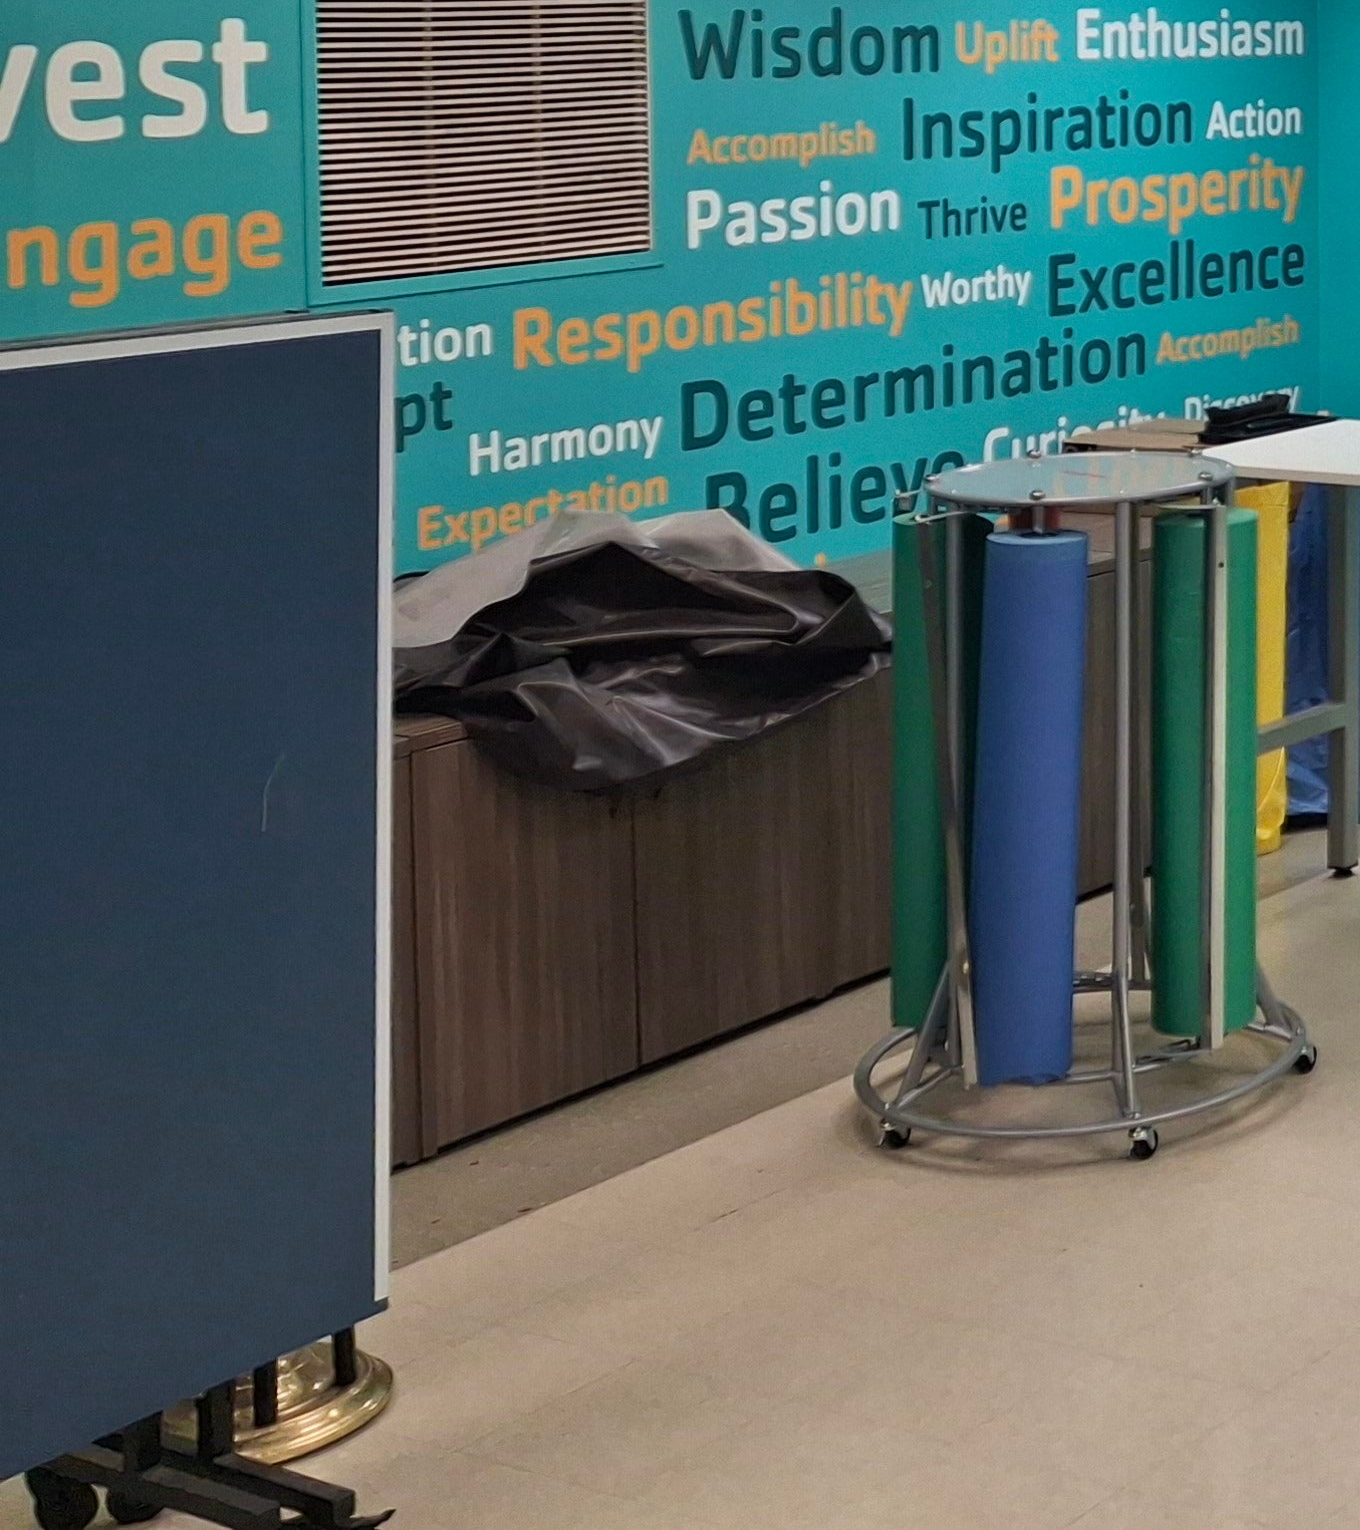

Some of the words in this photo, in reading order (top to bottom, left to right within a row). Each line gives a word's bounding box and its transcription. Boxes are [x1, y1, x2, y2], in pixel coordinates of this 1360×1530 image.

[679, 7, 938, 80] Wisdom
[957, 21, 1058, 73] Uplift
[1077, 8, 1303, 61] Enthusiasm
[688, 124, 875, 166] Accomplish
[904, 90, 1191, 173] Inspiration
[1206, 100, 1301, 139] Action
[687, 181, 900, 249] Passion
[918, 199, 1026, 239] Thrive
[1052, 156, 1303, 234] Prosperity
[7, 210, 282, 308] ngage
[397, 318, 493, 367] tion
[513, 272, 912, 372] Responsibility
[921, 265, 1032, 308] Worthy
[1050, 239, 1304, 316] Excellence
[394, 381, 453, 453] pt
[469, 415, 663, 476] Harmony
[681, 328, 1147, 452] Determination
[1158, 320, 1298, 360] Accomplish
